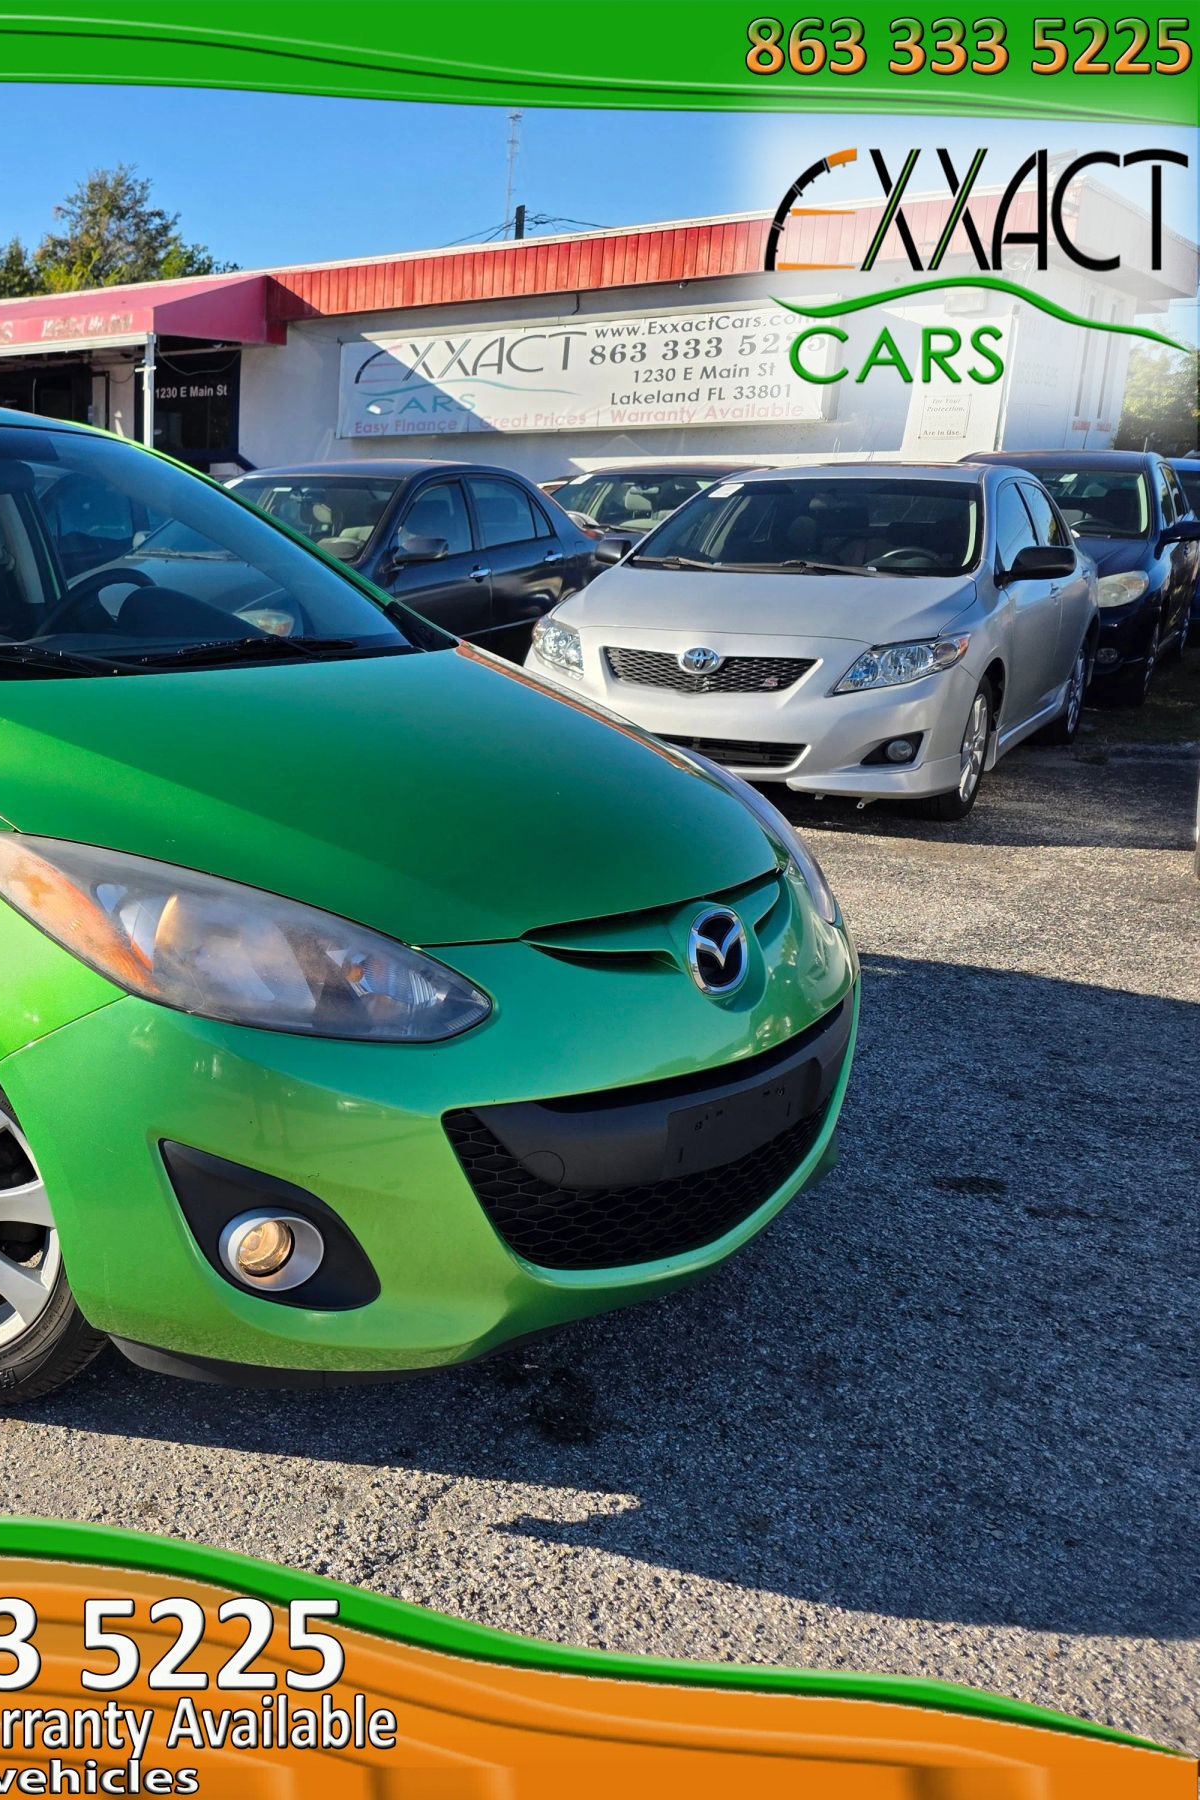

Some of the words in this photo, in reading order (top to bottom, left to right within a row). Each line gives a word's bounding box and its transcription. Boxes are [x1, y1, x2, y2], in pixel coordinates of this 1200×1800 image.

[354, 331, 588, 384] EXXACT
[589, 341, 647, 366] 863
[661, 336, 723, 361] 333
[633, 368, 676, 384] 1230
[683, 367, 694, 381] E
[700, 363, 750, 380] Main
[757, 362, 776, 377] St
[155, 387, 177, 399] 1230
[180, 386, 188, 398] E
[189, 385, 214, 397] Main
[216, 384, 228, 396] St
[610, 388, 700, 406] Lakeland
[707, 387, 726, 401] FL
[733, 384, 791, 400] 33801
[366, 393, 476, 416] CARS
[354, 420, 388, 434] Easy
[395, 418, 458, 433] Finance
[481, 414, 528, 430] Great
[534, 410, 587, 427] Prices
[610, 404, 697, 424] Warranty
[704, 403, 805, 420] Available
